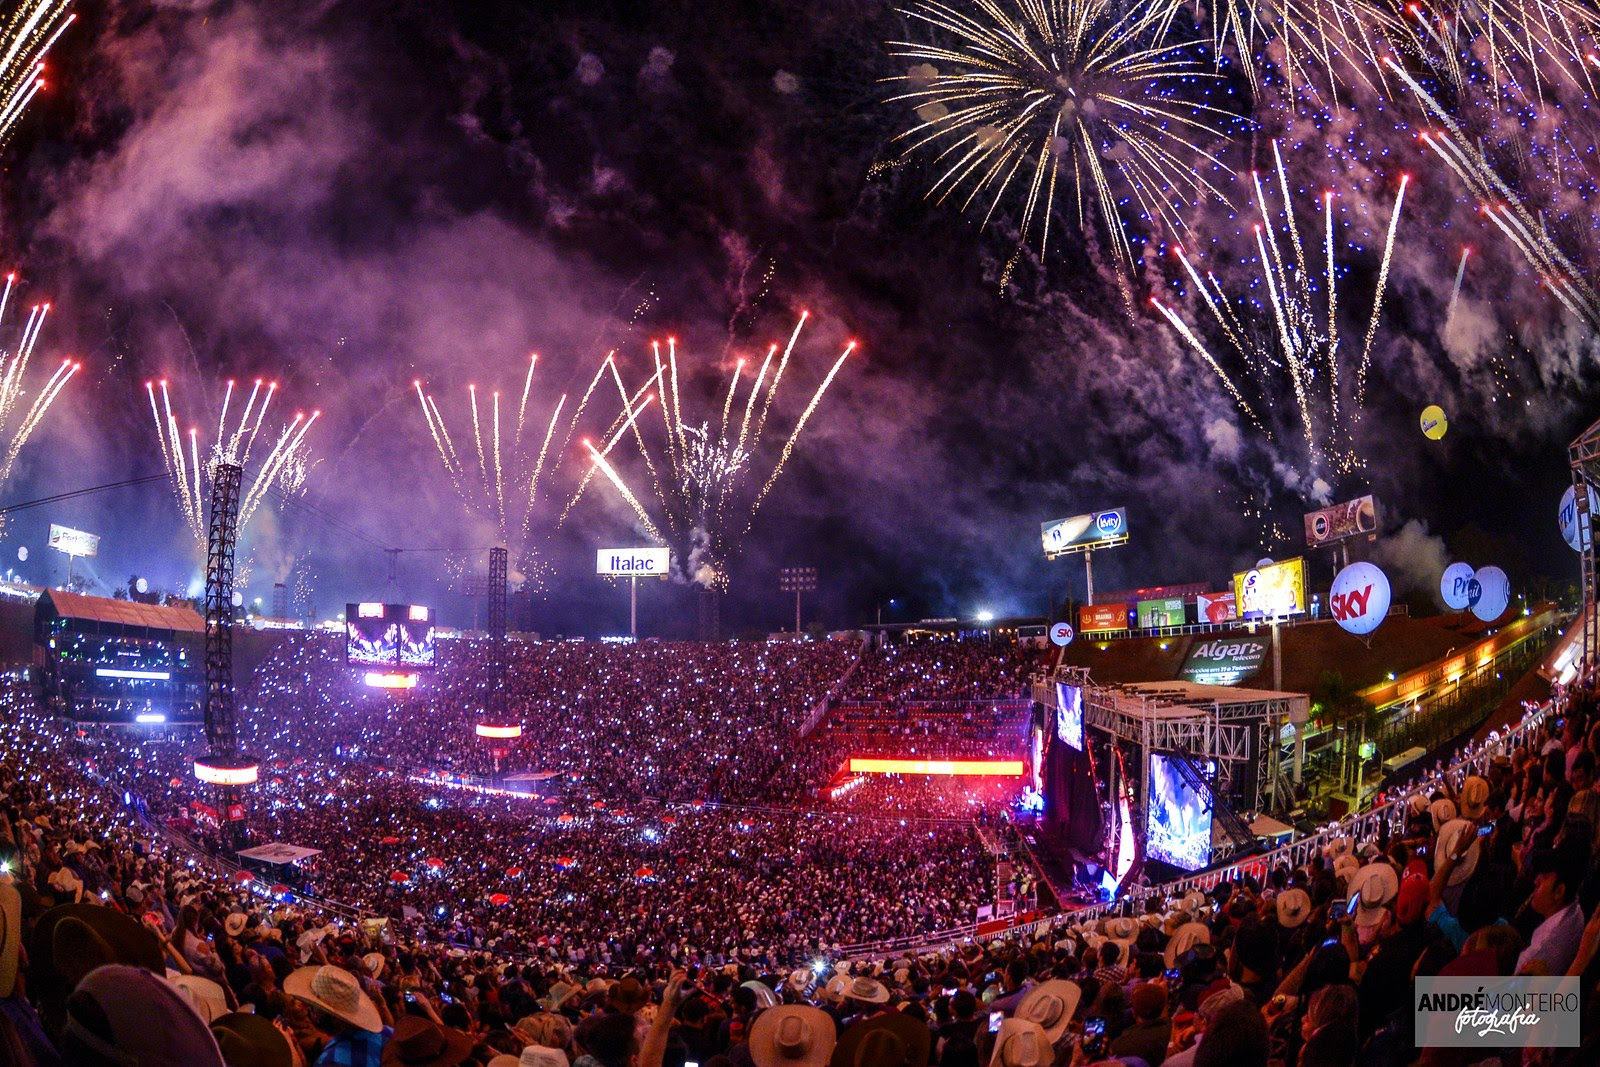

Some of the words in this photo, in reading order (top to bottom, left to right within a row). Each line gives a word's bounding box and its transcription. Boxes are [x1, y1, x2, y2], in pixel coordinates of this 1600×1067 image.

[610, 555, 654, 571] Italac
[1331, 584, 1374, 621] SKY
[1192, 641, 1251, 661] Algar
[1231, 654, 1260, 662] Telecom
